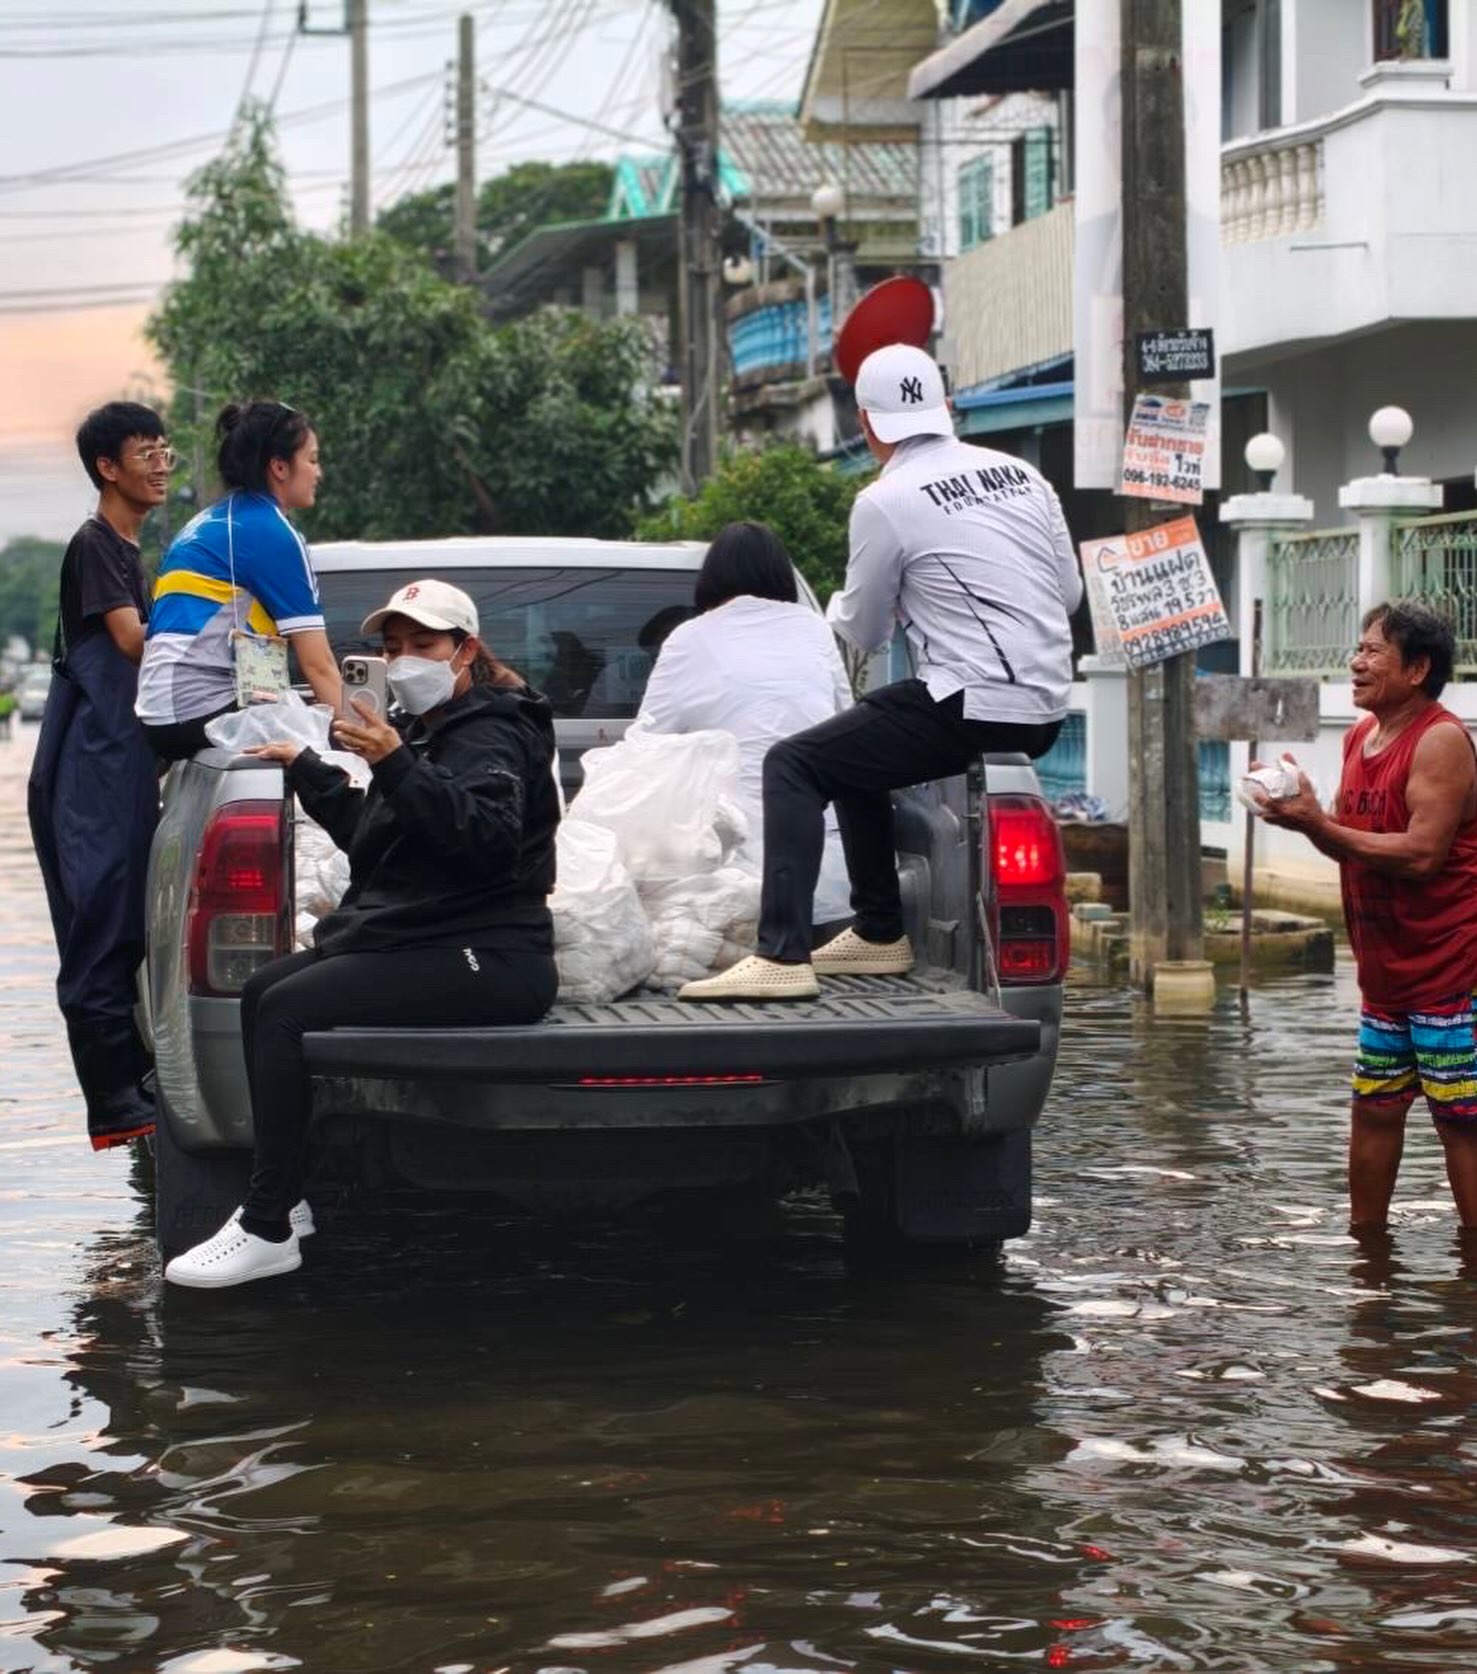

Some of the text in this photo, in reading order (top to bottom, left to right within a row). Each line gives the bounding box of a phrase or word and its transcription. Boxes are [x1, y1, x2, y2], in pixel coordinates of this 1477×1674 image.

[900, 376, 923, 404] NY
[920, 465, 1031, 506] THAI NAKA
[1130, 529, 1169, 556] ขาย
[1111, 549, 1201, 596] บ้านแฝด
